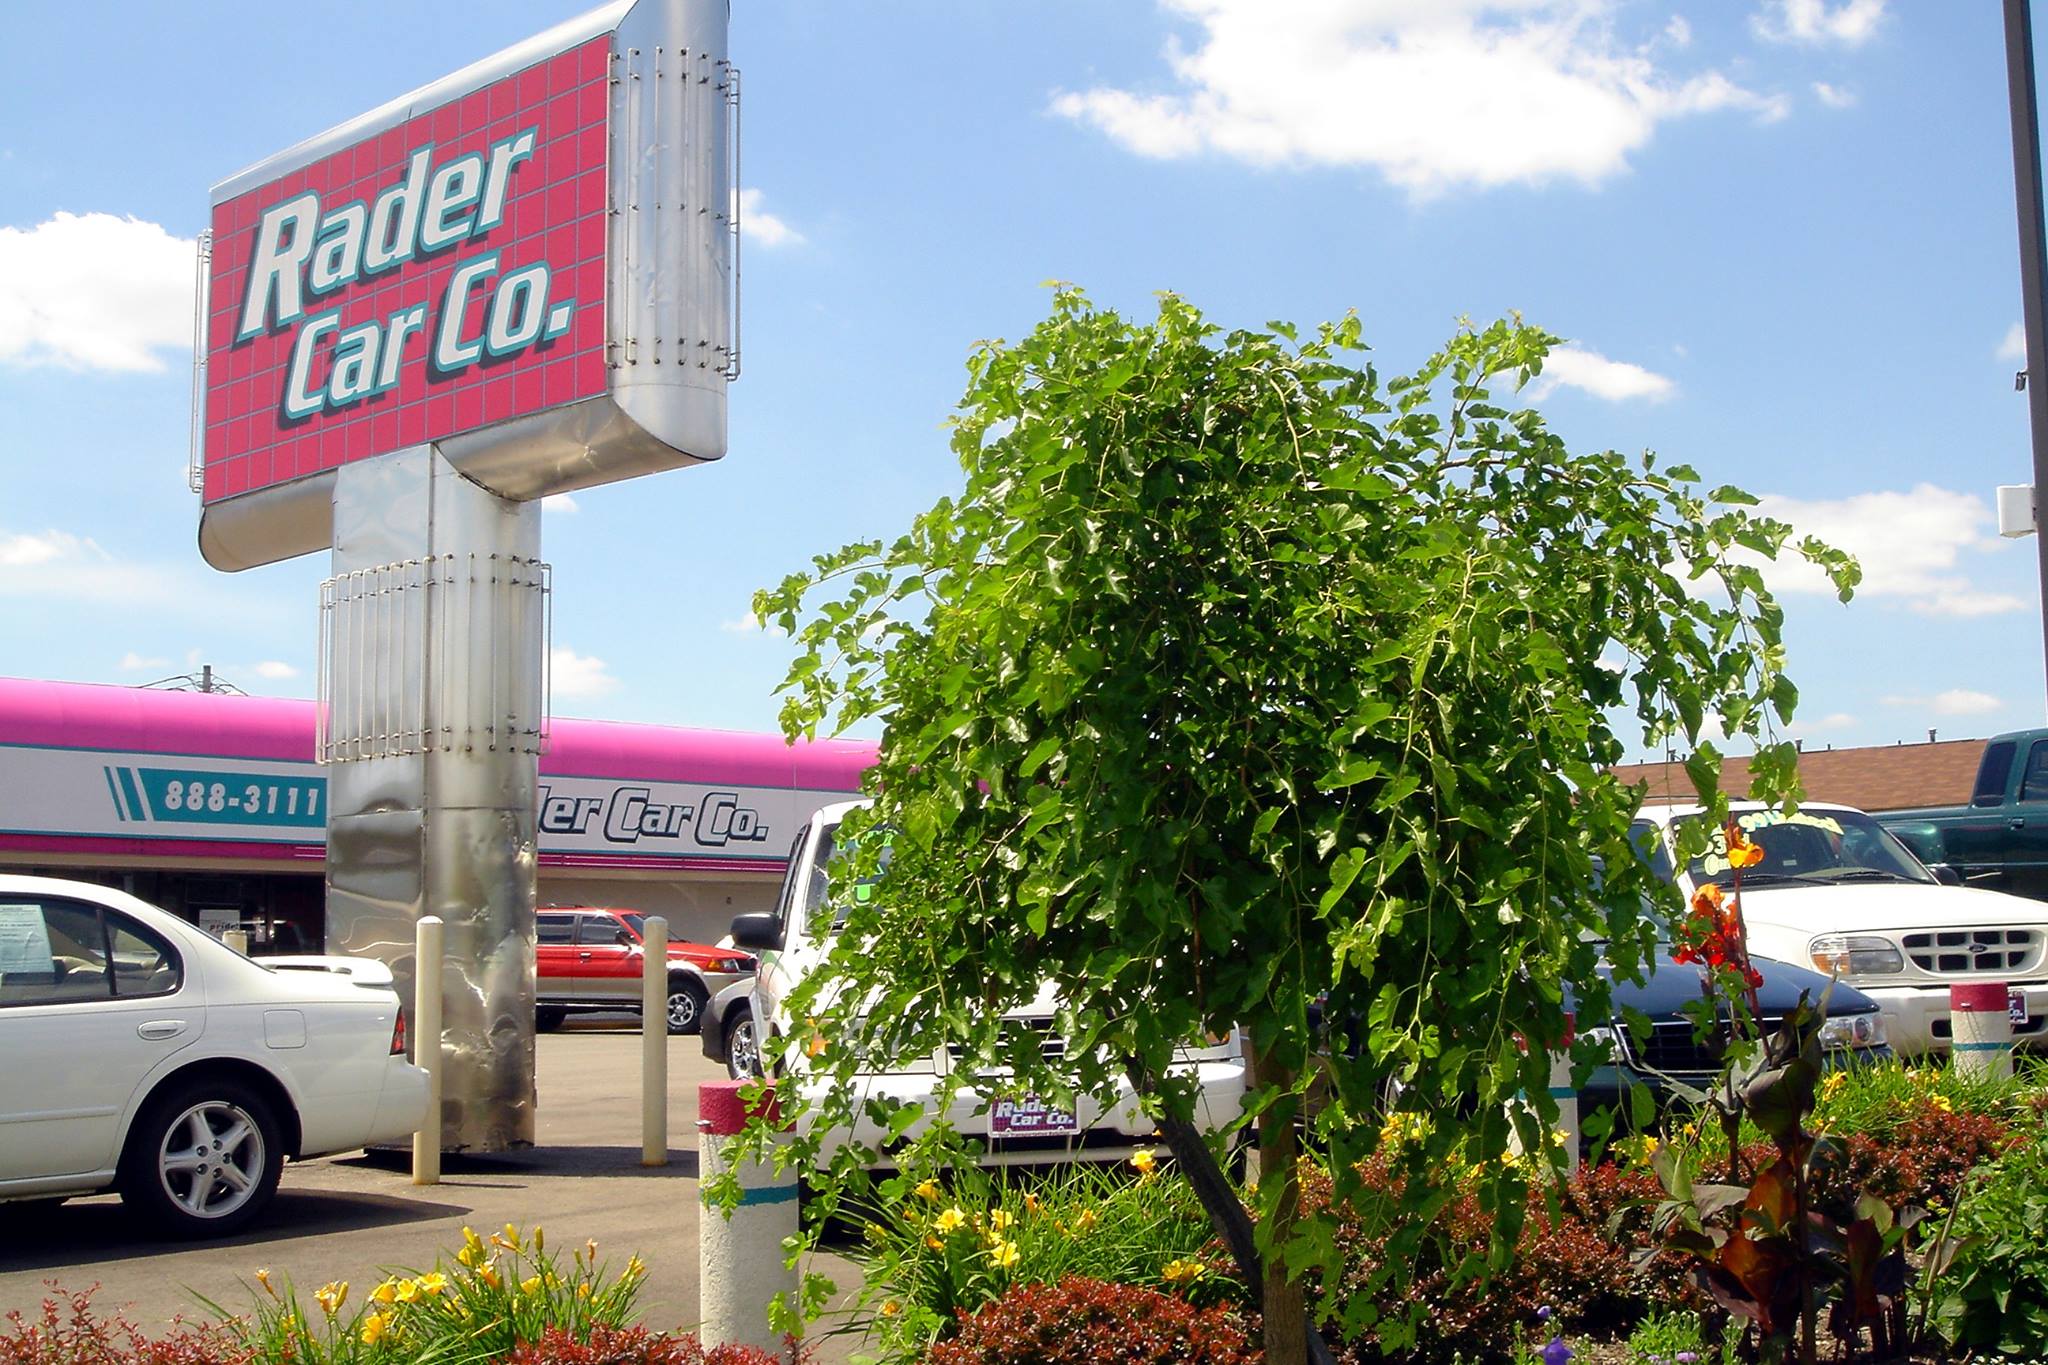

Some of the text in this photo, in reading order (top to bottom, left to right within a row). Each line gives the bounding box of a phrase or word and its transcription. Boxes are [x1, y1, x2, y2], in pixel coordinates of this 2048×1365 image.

[237, 125, 539, 341] Rader
[283, 251, 576, 419] Car Co.
[165, 780, 319, 816] 888-3111
[604, 787, 694, 843] Car
[695, 792, 769, 847] Co.
[996, 1099, 1058, 1117] Rad
[1010, 1112, 1074, 1126] Car Co.
